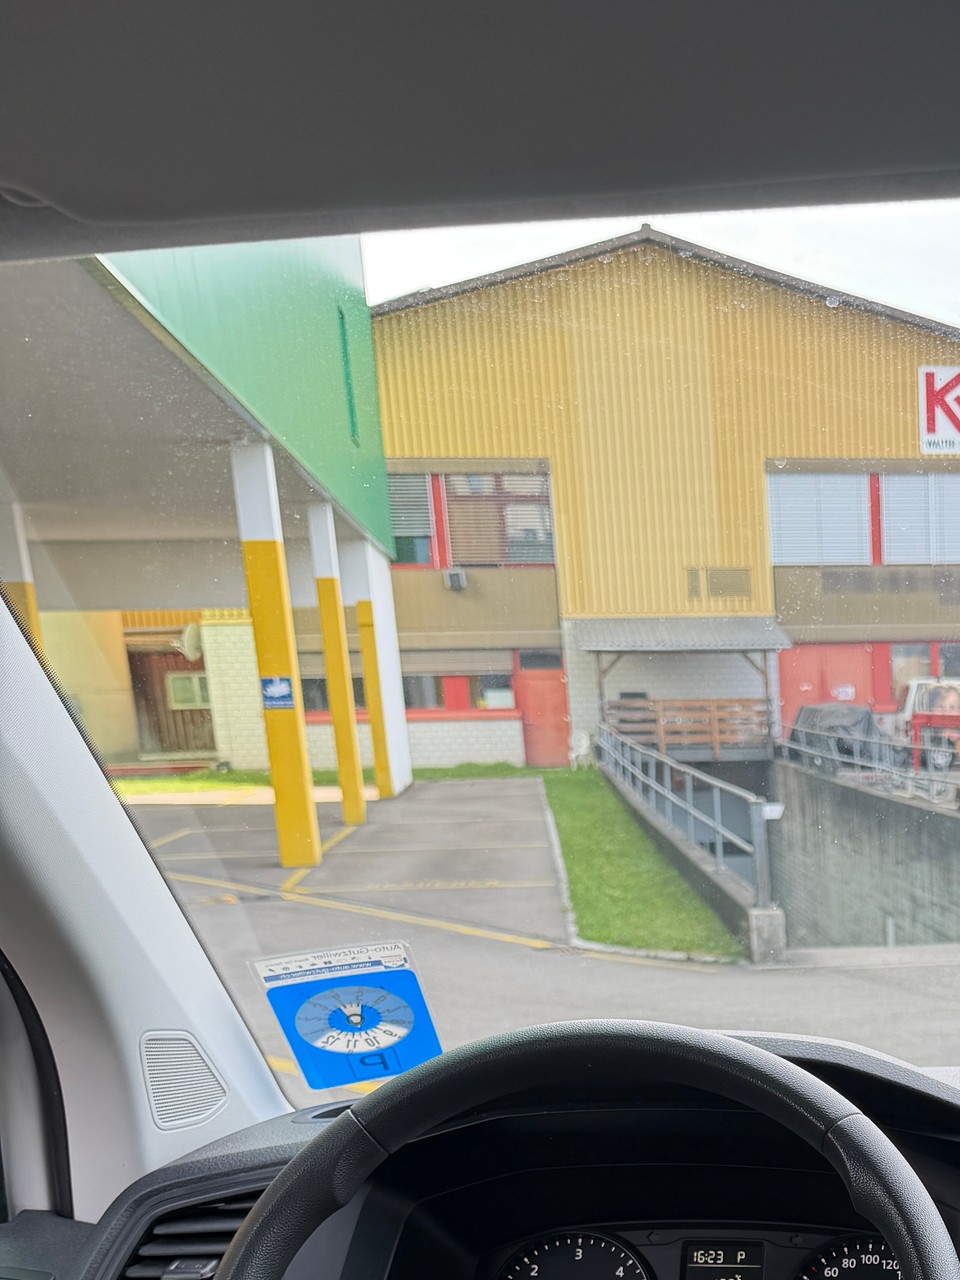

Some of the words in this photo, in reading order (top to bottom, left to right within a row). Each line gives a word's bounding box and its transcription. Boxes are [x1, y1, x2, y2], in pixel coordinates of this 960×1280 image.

[574, 1248, 583, 1260] 3
[693, 1250, 724, 1264] 16:23
[736, 1250, 746, 1264] P
[860, 1254, 880, 1265] 100
[841, 1258, 857, 1269] 80
[881, 1259, 900, 1270] 120
[530, 1264, 539, 1277] 2
[615, 1266, 625, 1278] 4
[823, 1267, 839, 1278] 60
